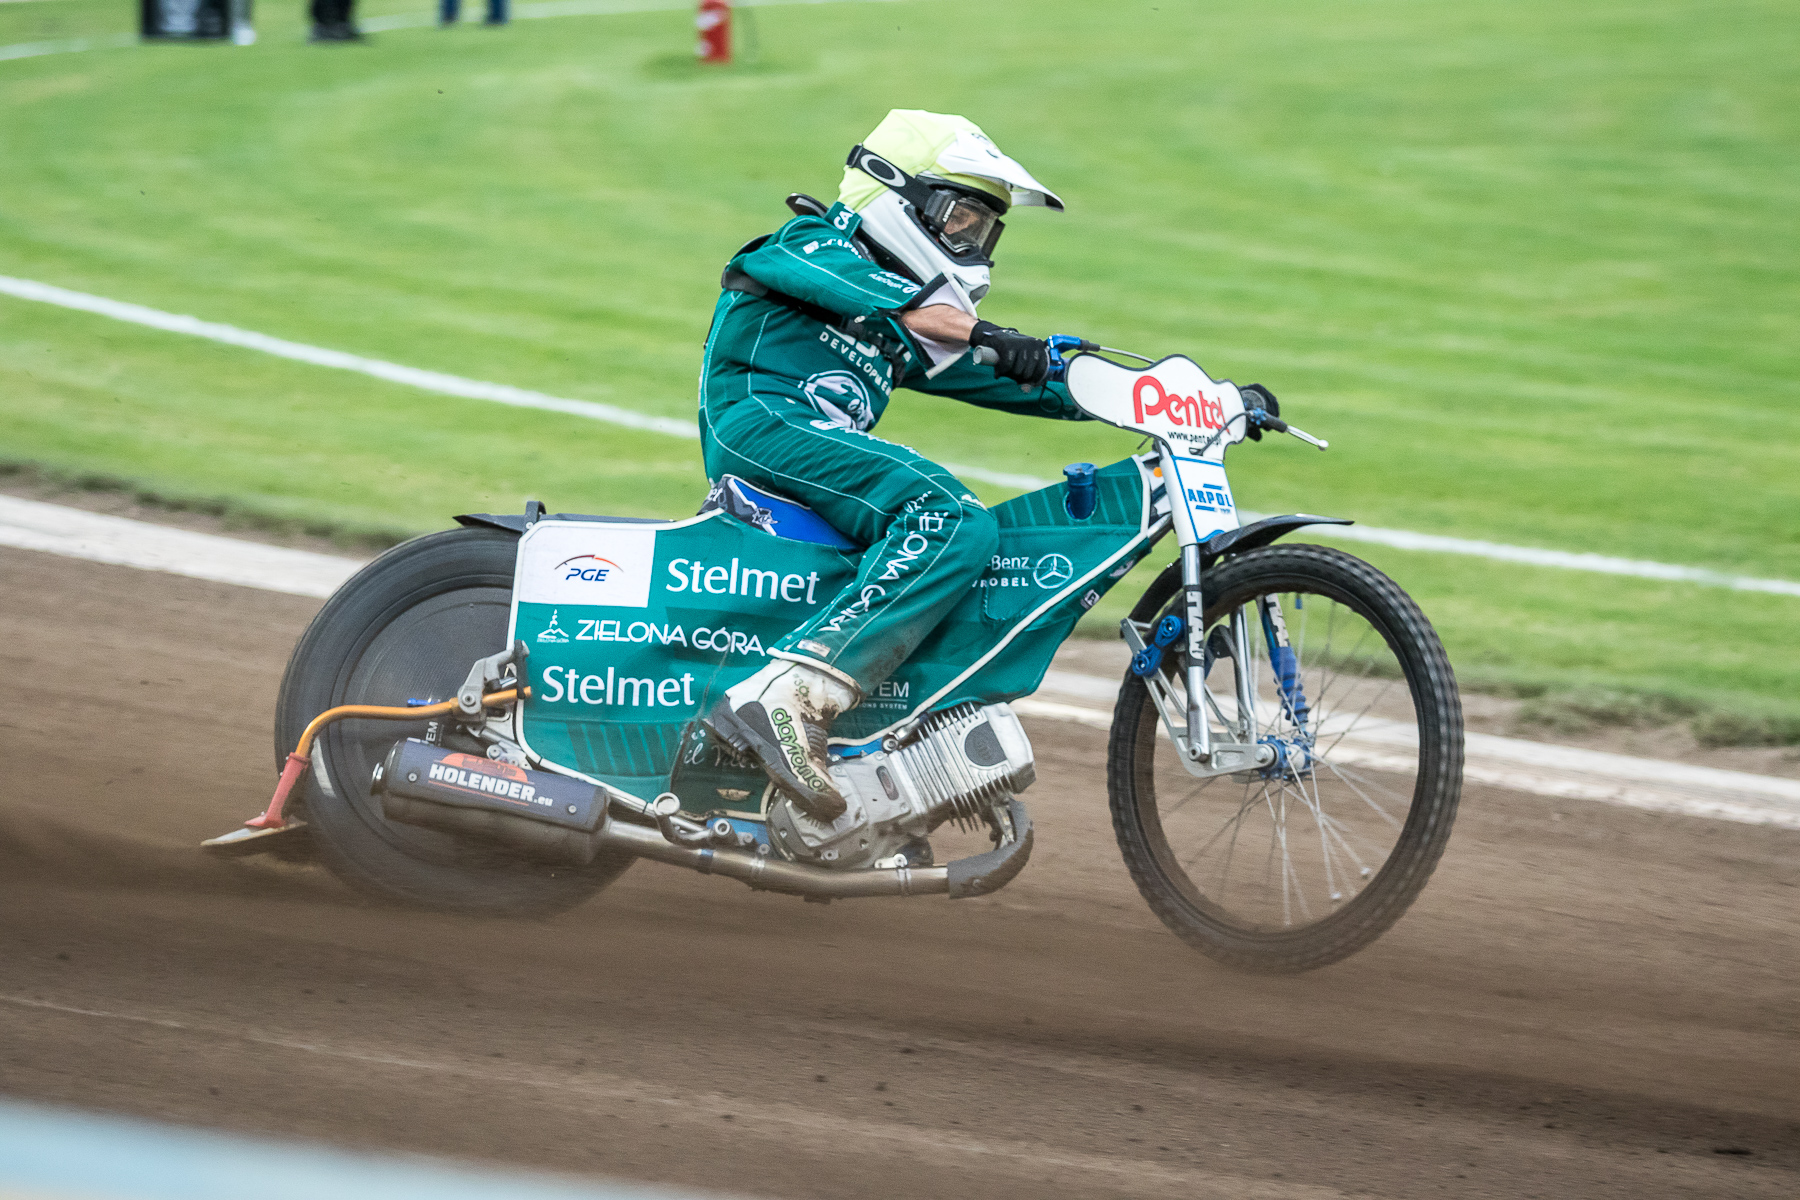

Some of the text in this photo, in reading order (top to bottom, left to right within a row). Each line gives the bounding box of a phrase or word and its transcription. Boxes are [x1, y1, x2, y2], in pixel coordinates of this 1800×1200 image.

[1132, 375, 1231, 436] Pentel
[1187, 488, 1232, 507] ARPOL
[565, 568, 609, 582] PGE
[666, 557, 820, 605] Stelmet
[575, 619, 688, 648] ZIELONA
[691, 626, 766, 657] GÓRA
[541, 665, 695, 707] Stelmet
